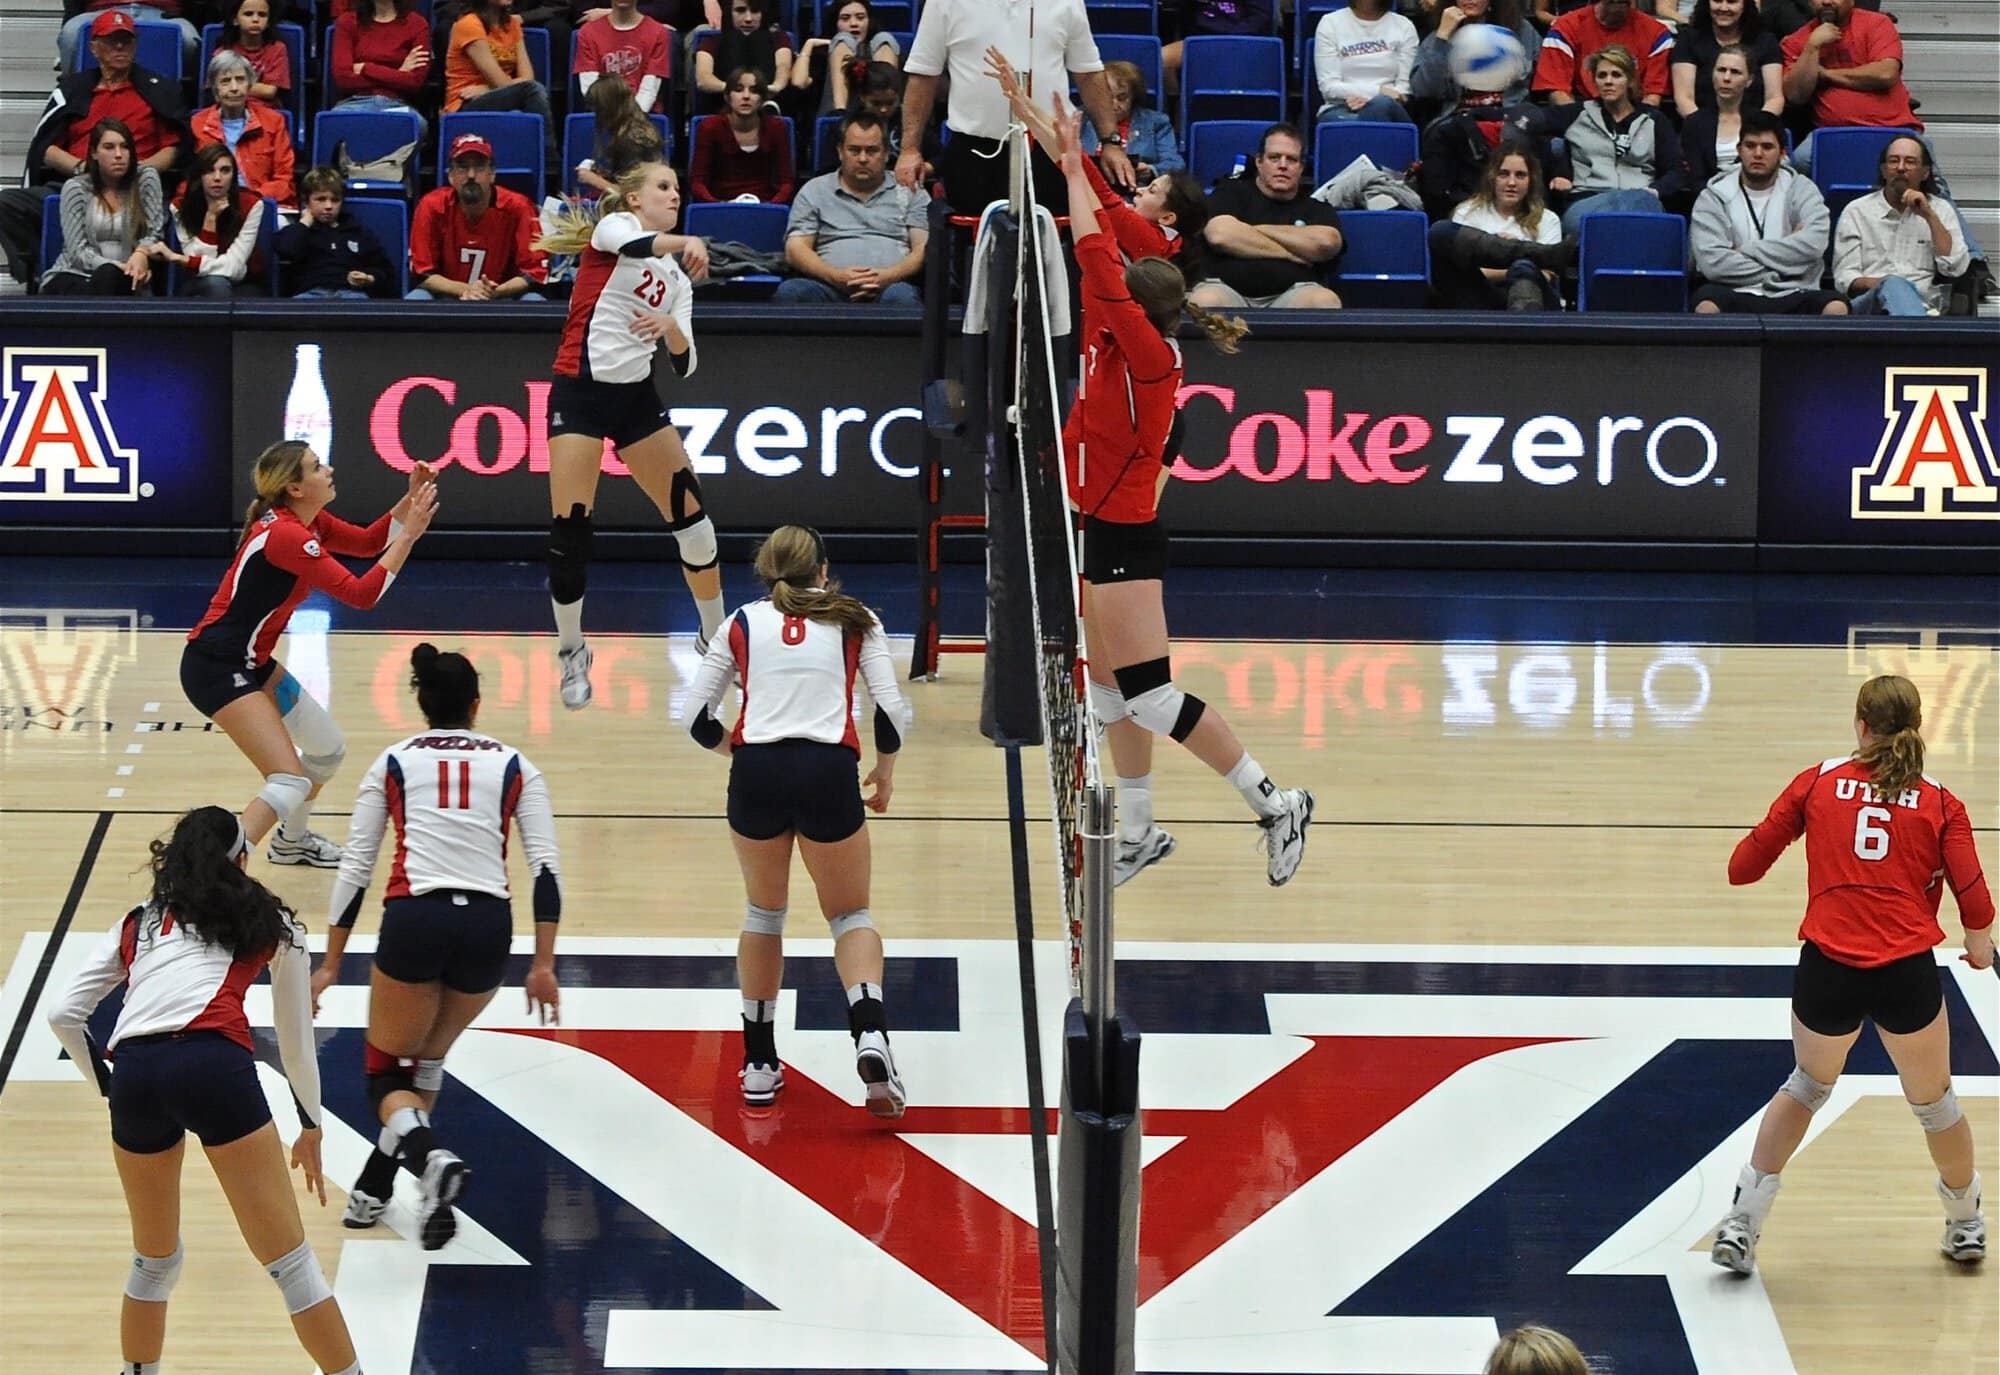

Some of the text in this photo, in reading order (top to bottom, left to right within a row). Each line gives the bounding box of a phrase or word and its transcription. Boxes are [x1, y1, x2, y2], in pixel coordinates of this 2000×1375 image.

[460, 247, 486, 286] 7
[633, 269, 667, 308] 23
[0, 347, 139, 501] A
[1171, 384, 1432, 484] Coke
[1851, 366, 2000, 520] A
[782, 612, 807, 646] 8
[438, 760, 470, 810] 11
[1836, 778, 1920, 810] UTH
[1854, 806, 1892, 861] 6
